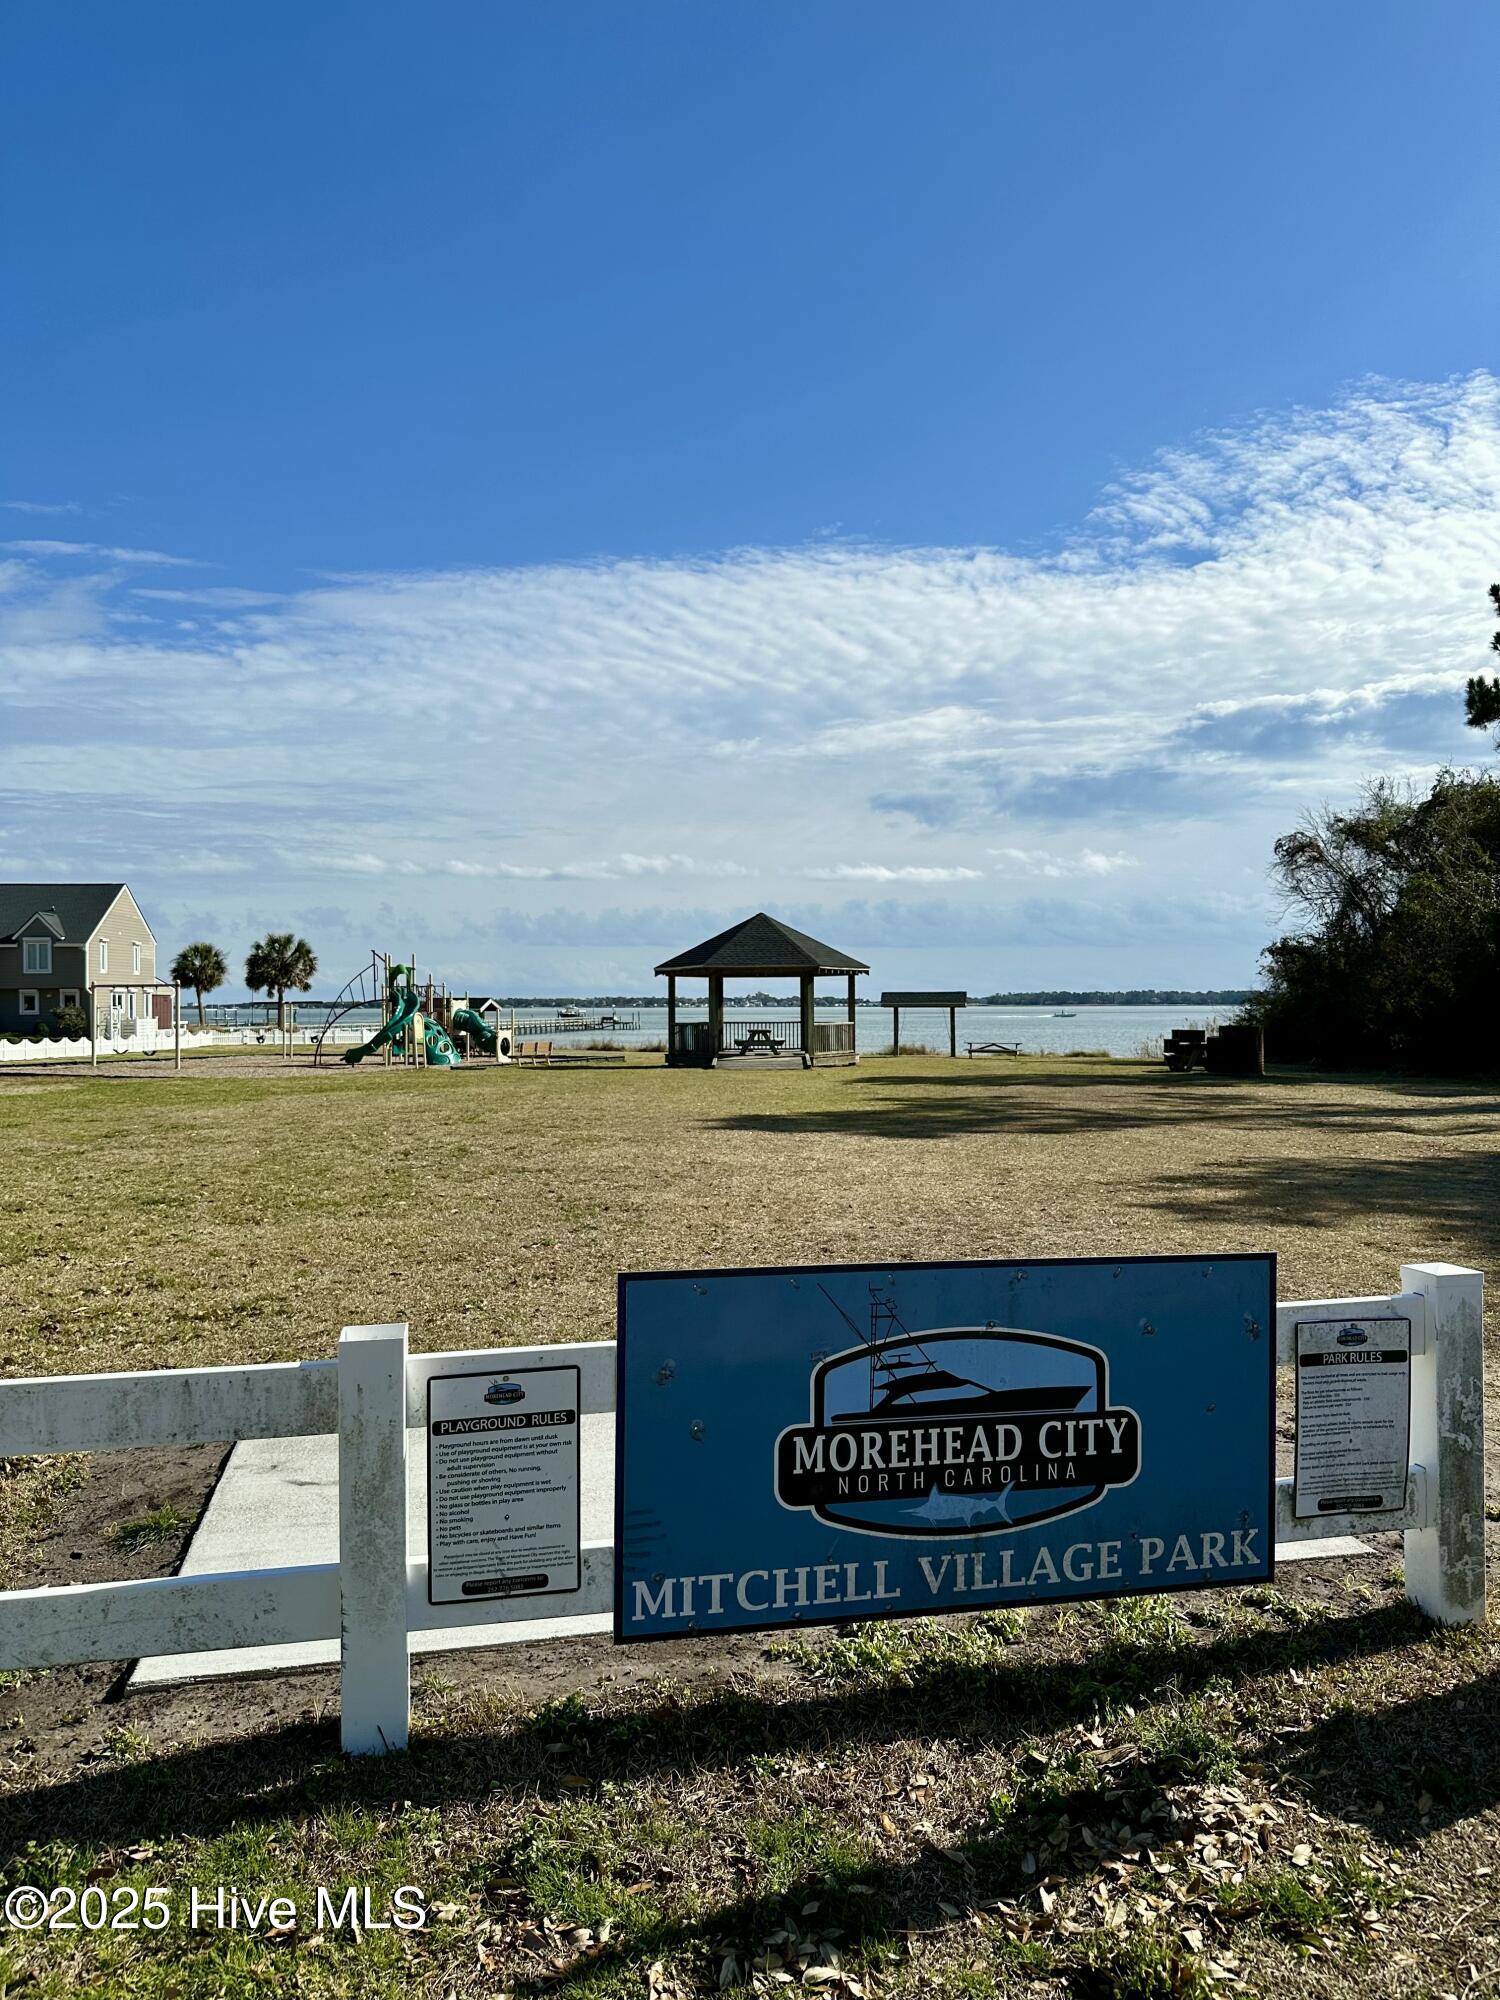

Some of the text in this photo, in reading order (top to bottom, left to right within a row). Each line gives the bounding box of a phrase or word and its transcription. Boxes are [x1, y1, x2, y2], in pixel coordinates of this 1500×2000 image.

[1323, 1352, 1382, 1364] PARK RULES
[441, 1412, 567, 1433] PLAYGROUND RULES
[439, 1441, 471, 1449] Playground
[792, 1417, 1129, 1475] MOREHEAD CITY
[458, 1447, 490, 1456] playground
[471, 1454, 503, 1462] playground
[463, 1462, 495, 1470] supervision
[447, 1479, 470, 1487] pushing
[504, 1480, 534, 1488] equipment
[838, 1463, 1077, 1495] NORTH CAROLINA
[471, 1491, 503, 1499] playground
[504, 1488, 535, 1496] equipment
[536, 1485, 566, 1493] improperly
[631, 1529, 1262, 1621] MITCHELL VILLAGE PARK
